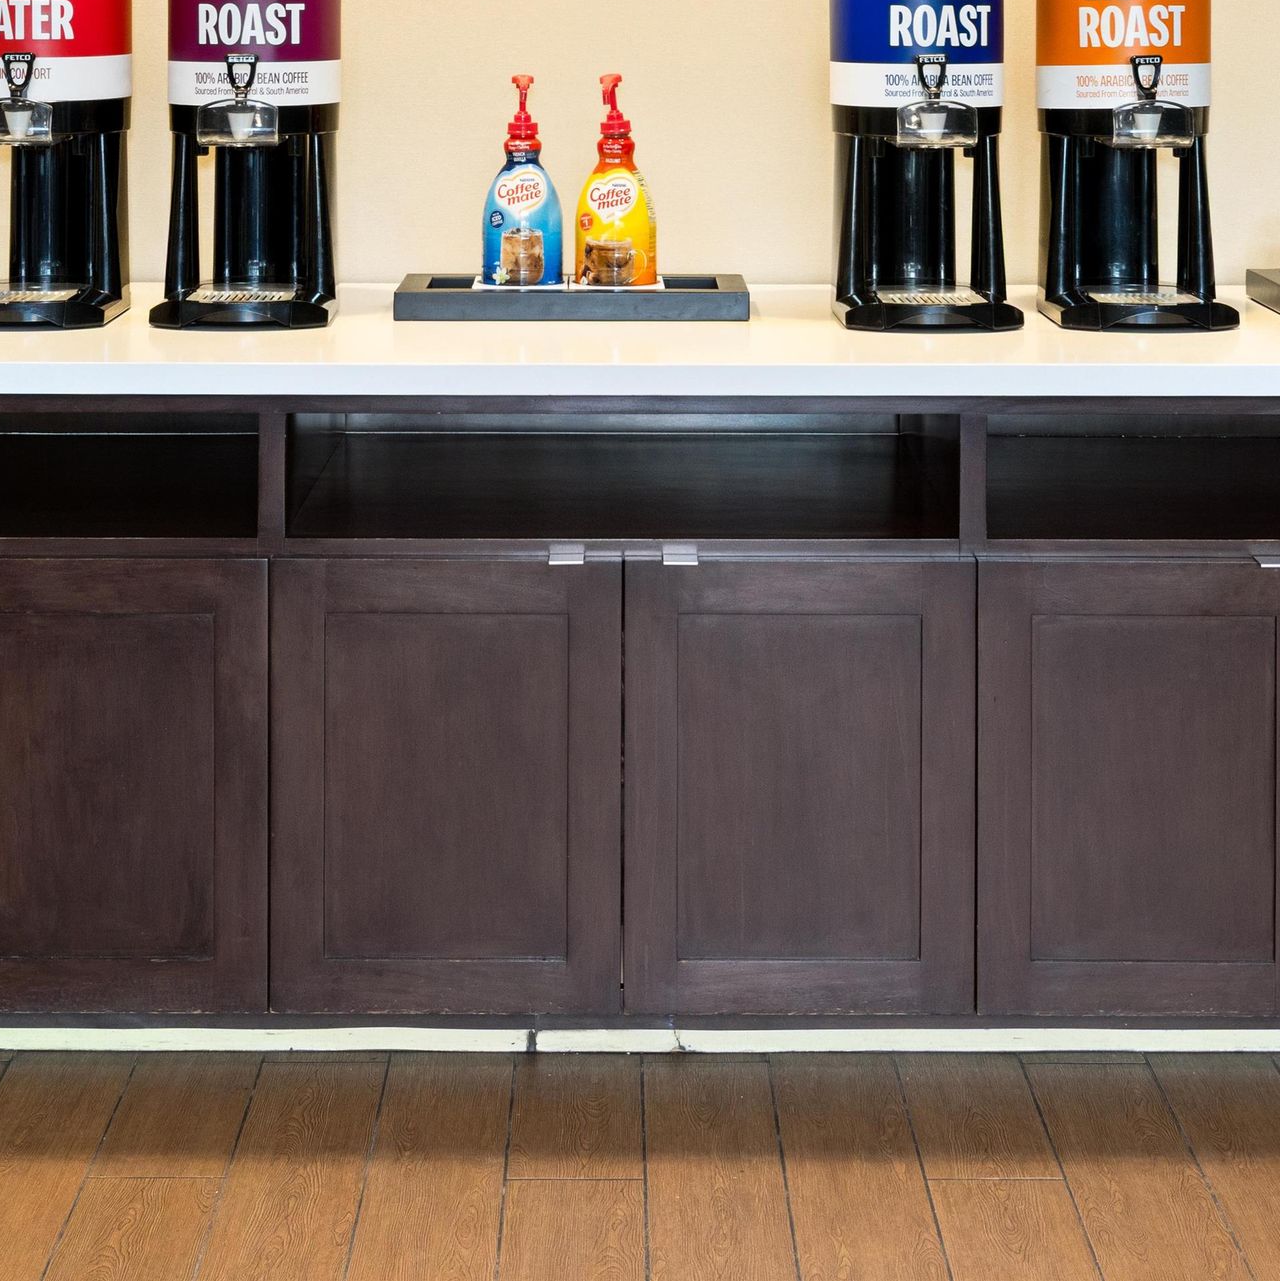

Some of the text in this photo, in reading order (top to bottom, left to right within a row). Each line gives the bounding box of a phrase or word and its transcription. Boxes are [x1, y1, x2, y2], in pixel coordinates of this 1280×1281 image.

[198, 3, 305, 45] ROAST
[889, 4, 991, 47] ROAST
[1078, 4, 1186, 48] ROAST
[1135, 56, 1161, 64] FETCO
[10, 67, 52, 80] COMORT
[194, 71, 309, 85] 100% ARBIC BEAN COFFEE
[885, 74, 909, 87] 100%
[951, 74, 972, 86] BEAN
[974, 73, 993, 86] COFFEE
[1076, 73, 1189, 88] 100% ARABIC BEN COFFEE
[194, 86, 217, 96] Sourced
[259, 86, 265, 96] &
[266, 86, 284, 96] South
[285, 86, 309, 95] America
[884, 88, 910, 97] Sourced
[953, 89, 959, 97] &
[960, 89, 976, 97] South
[497, 182, 540, 199] Coffee
[507, 189, 542, 206] mate
[589, 187, 631, 202] Coffee
[597, 195, 632, 210] mate
